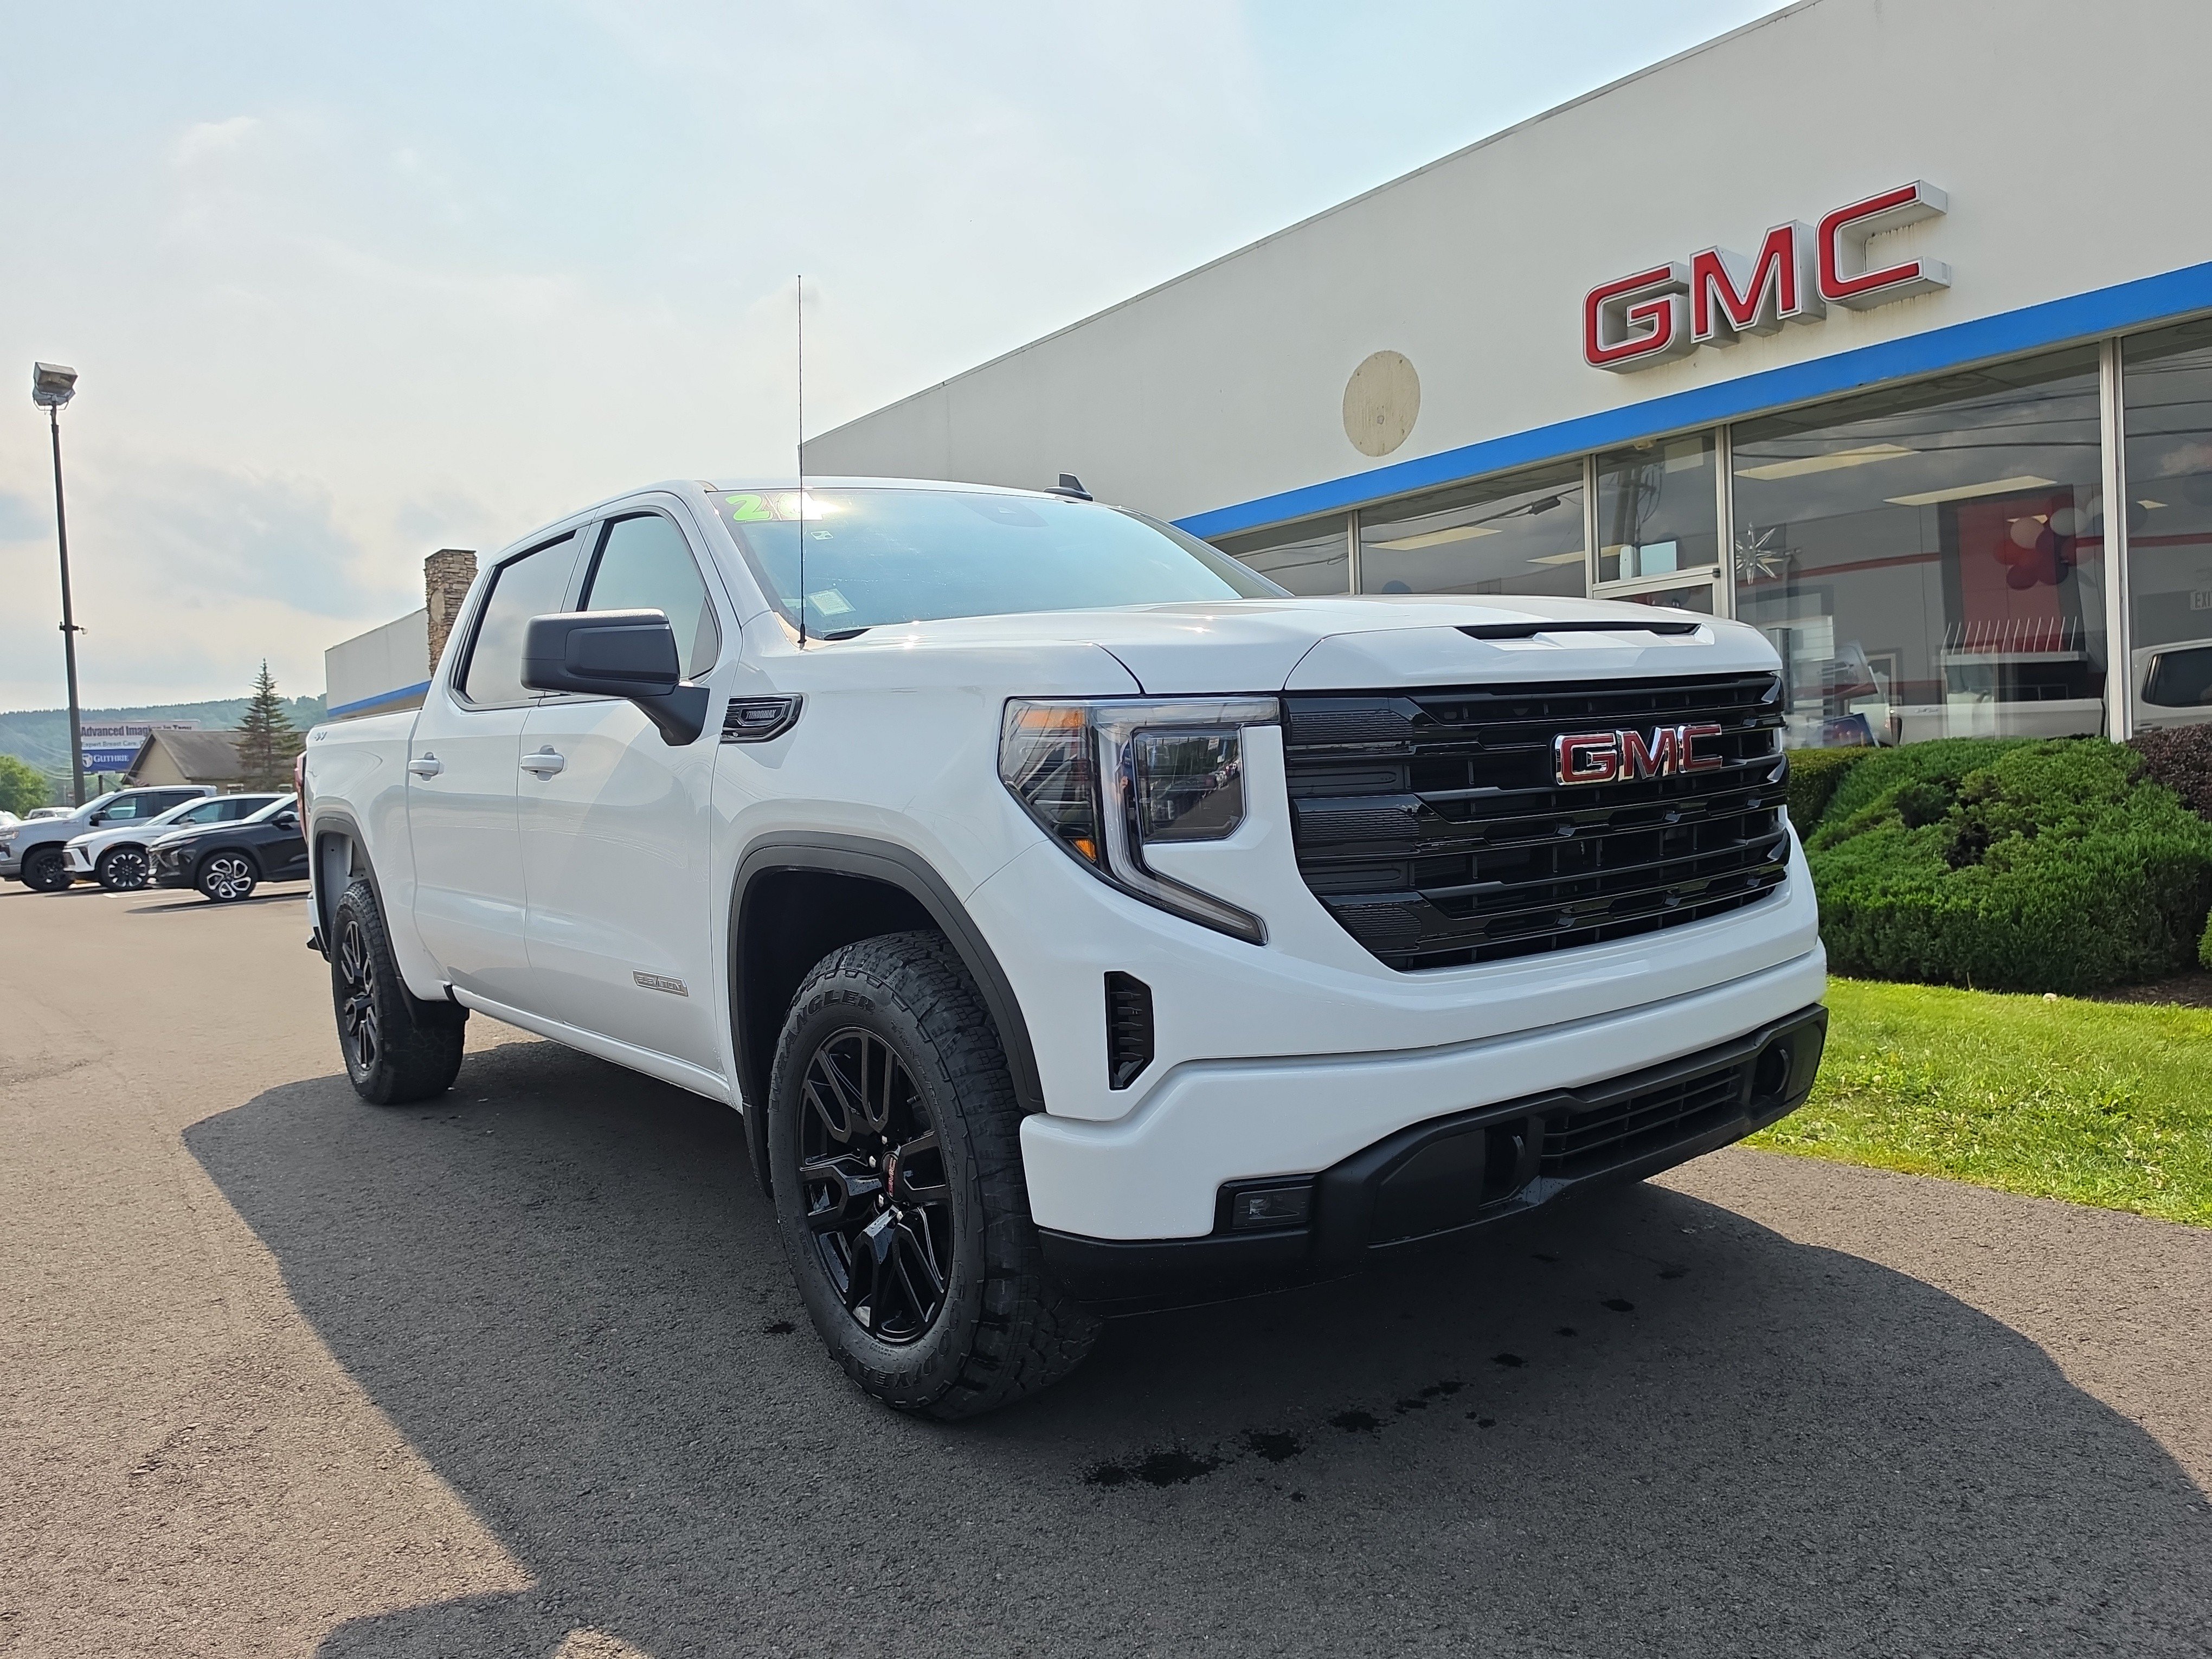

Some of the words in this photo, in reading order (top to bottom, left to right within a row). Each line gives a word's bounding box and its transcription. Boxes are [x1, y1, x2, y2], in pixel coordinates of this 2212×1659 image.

[1582, 179, 1947, 371] GMC
[2195, 591, 2212, 608] EXI
[745, 709, 777, 719] TURBOMAX
[81, 726, 124, 736] Advanced
[93, 754, 130, 763] GUTHRIE
[1555, 724, 1722, 786] GMC
[636, 975, 681, 991] ELEVATION
[770, 989, 876, 1112] WRANGLER
[888, 1157, 896, 1197] GMC
[838, 1260, 967, 1390] GOODYEAR
